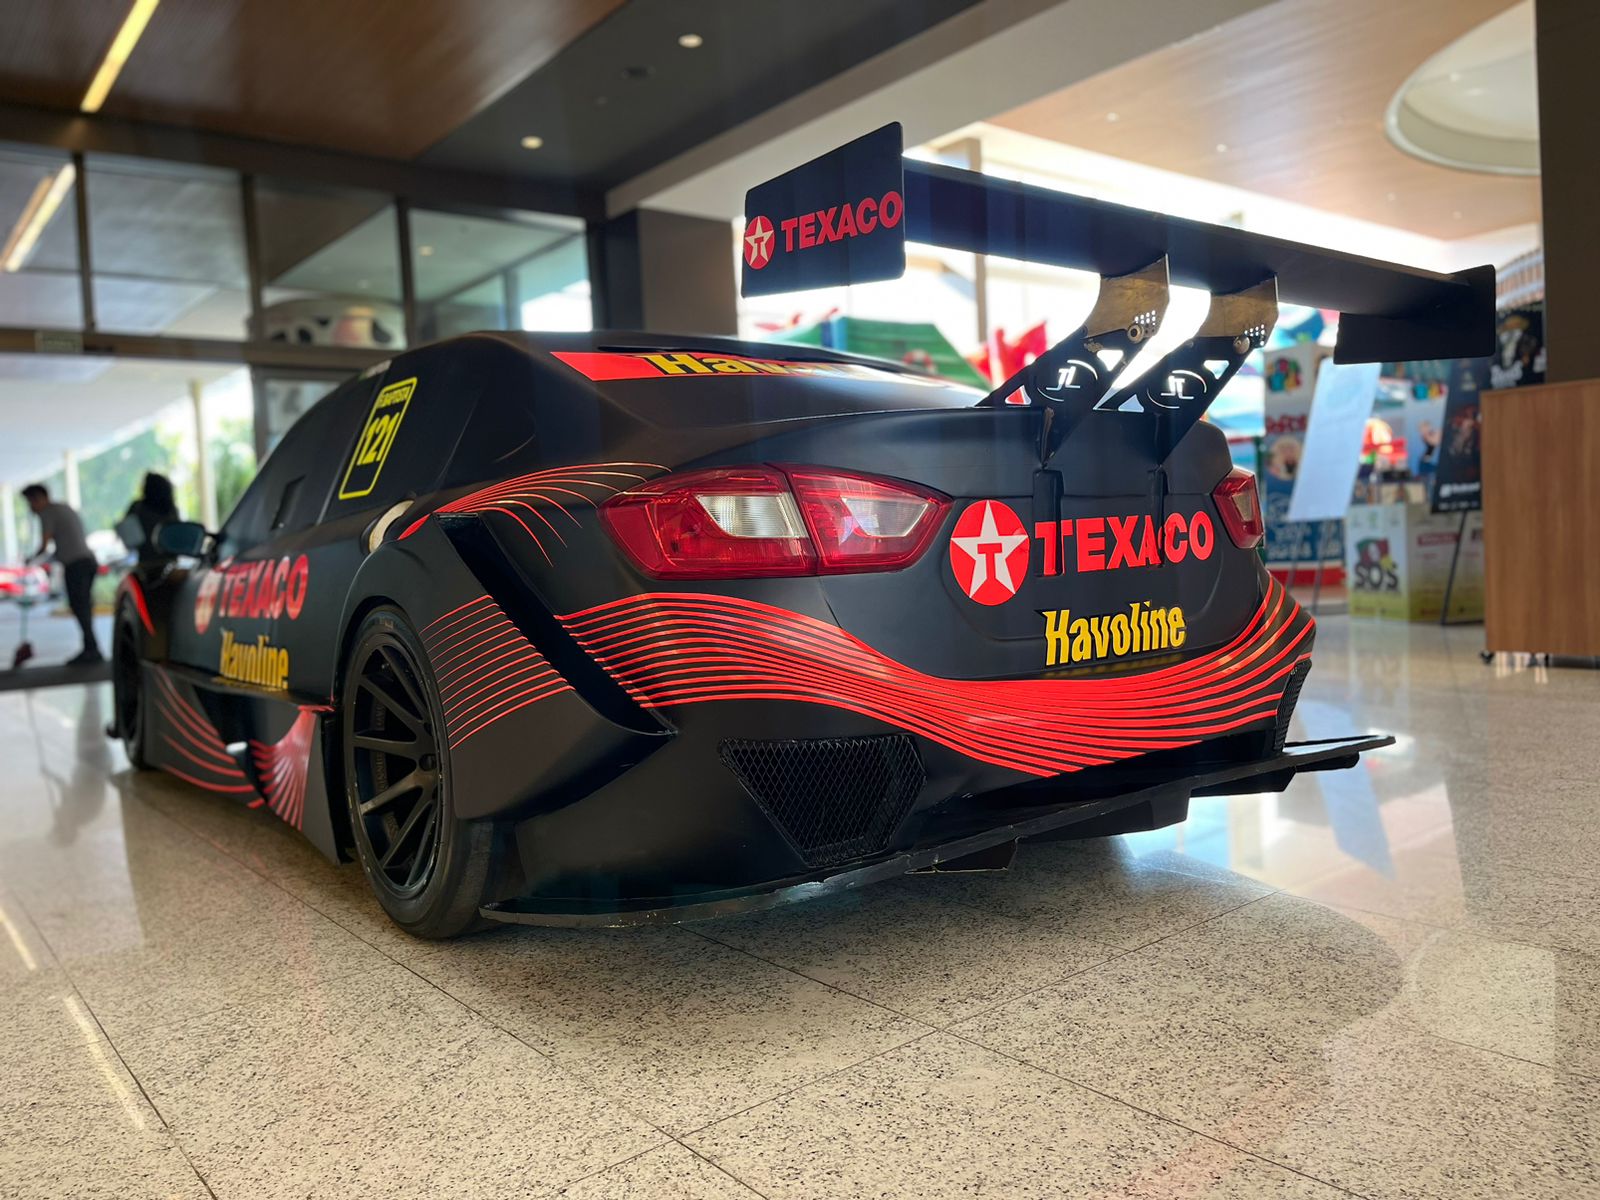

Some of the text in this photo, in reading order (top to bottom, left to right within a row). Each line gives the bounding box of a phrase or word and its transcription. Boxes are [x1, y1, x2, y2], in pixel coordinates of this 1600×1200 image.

[780, 190, 904, 253] TEXACO
[356, 411, 400, 467] 121
[1034, 511, 1214, 577] TEXACO
[1354, 561, 1399, 590] SOS
[214, 554, 309, 620] TEXACO
[219, 629, 289, 690] Havoline
[1041, 600, 1186, 667] Havoline
